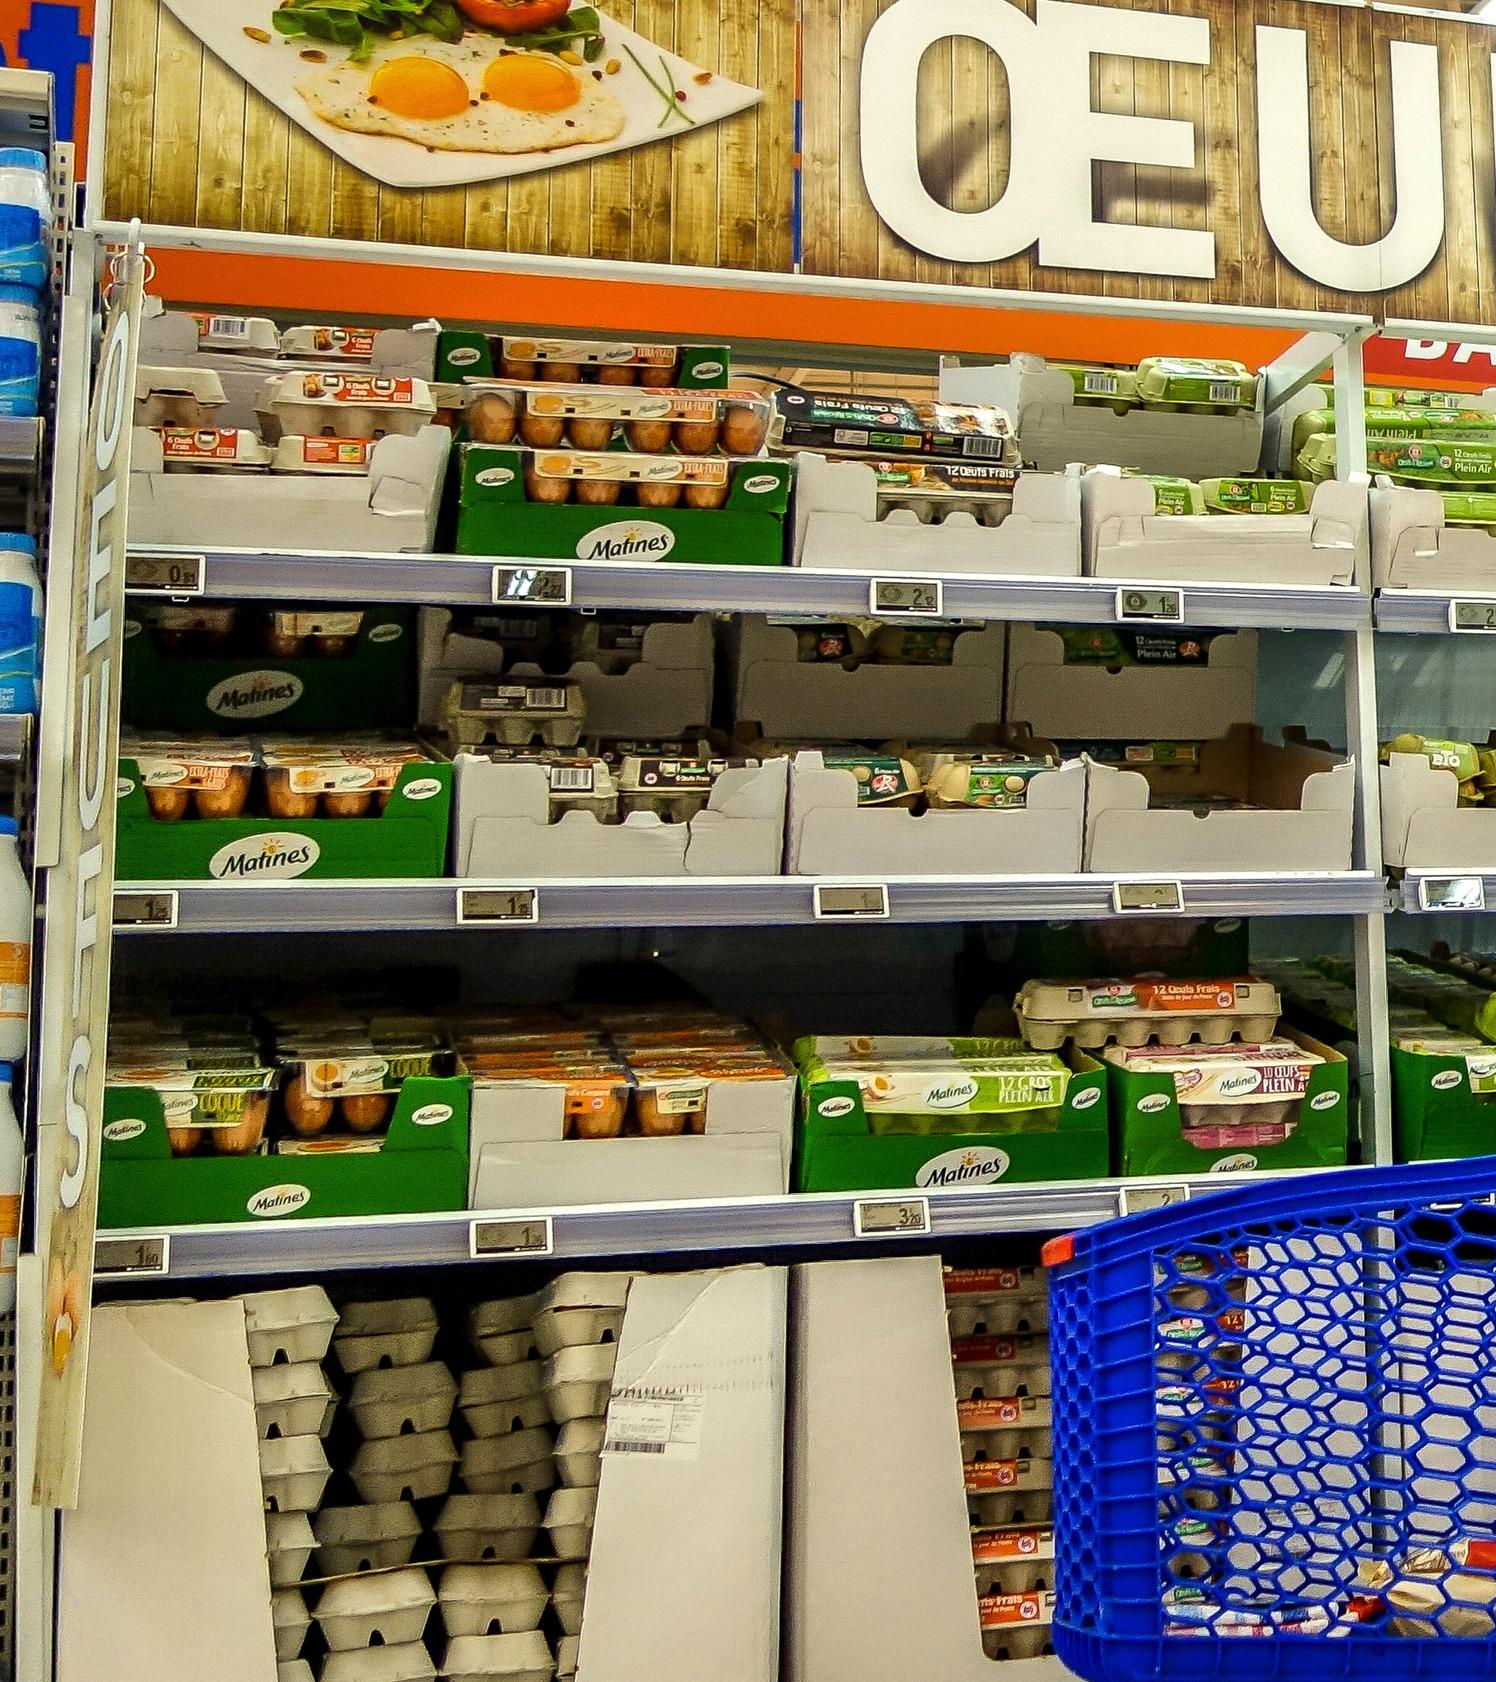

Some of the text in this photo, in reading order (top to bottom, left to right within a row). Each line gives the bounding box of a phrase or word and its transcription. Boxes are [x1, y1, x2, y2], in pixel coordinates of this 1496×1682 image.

[1454, 462, 1493, 474] Plein Air
[590, 531, 670, 560] Matines
[1432, 755, 1460, 768] BIO
[220, 845, 312, 877] Matines
[1152, 984, 1166, 994] 12
[999, 1077, 1014, 1091] 12
[1219, 1074, 1258, 1091] Matines
[1263, 1079, 1296, 1092] PLEIN
[926, 1084, 974, 1103] Matines
[923, 1157, 1001, 1188] Matines
[255, 1190, 306, 1211] Matines
